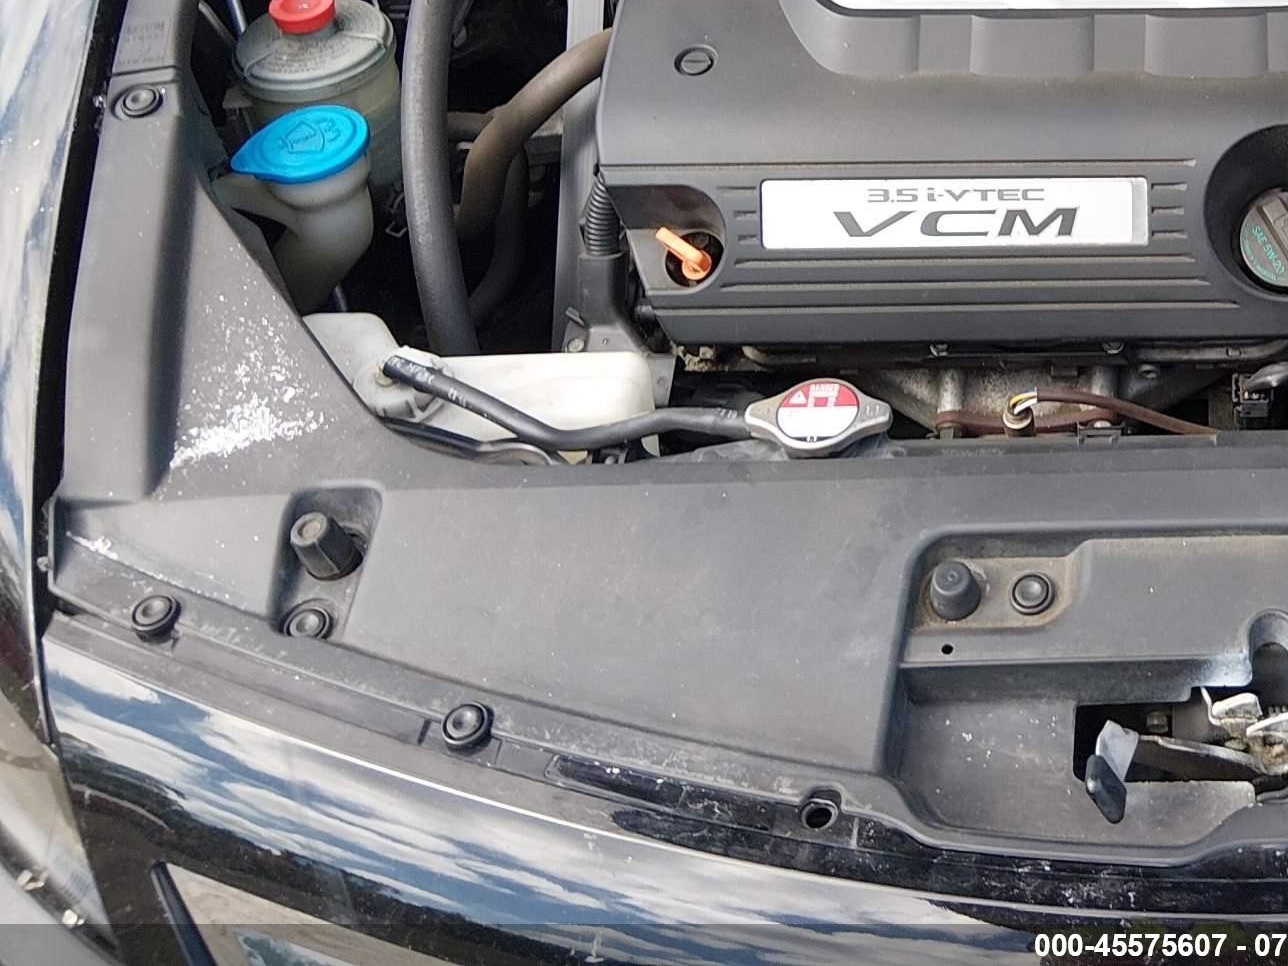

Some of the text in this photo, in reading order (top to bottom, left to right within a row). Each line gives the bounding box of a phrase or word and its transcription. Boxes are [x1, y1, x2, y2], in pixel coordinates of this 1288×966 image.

[869, 187, 1044, 203] 3.5 i-VTEC
[833, 207, 1079, 239] VCM
[1251, 225, 1267, 245] SAE
